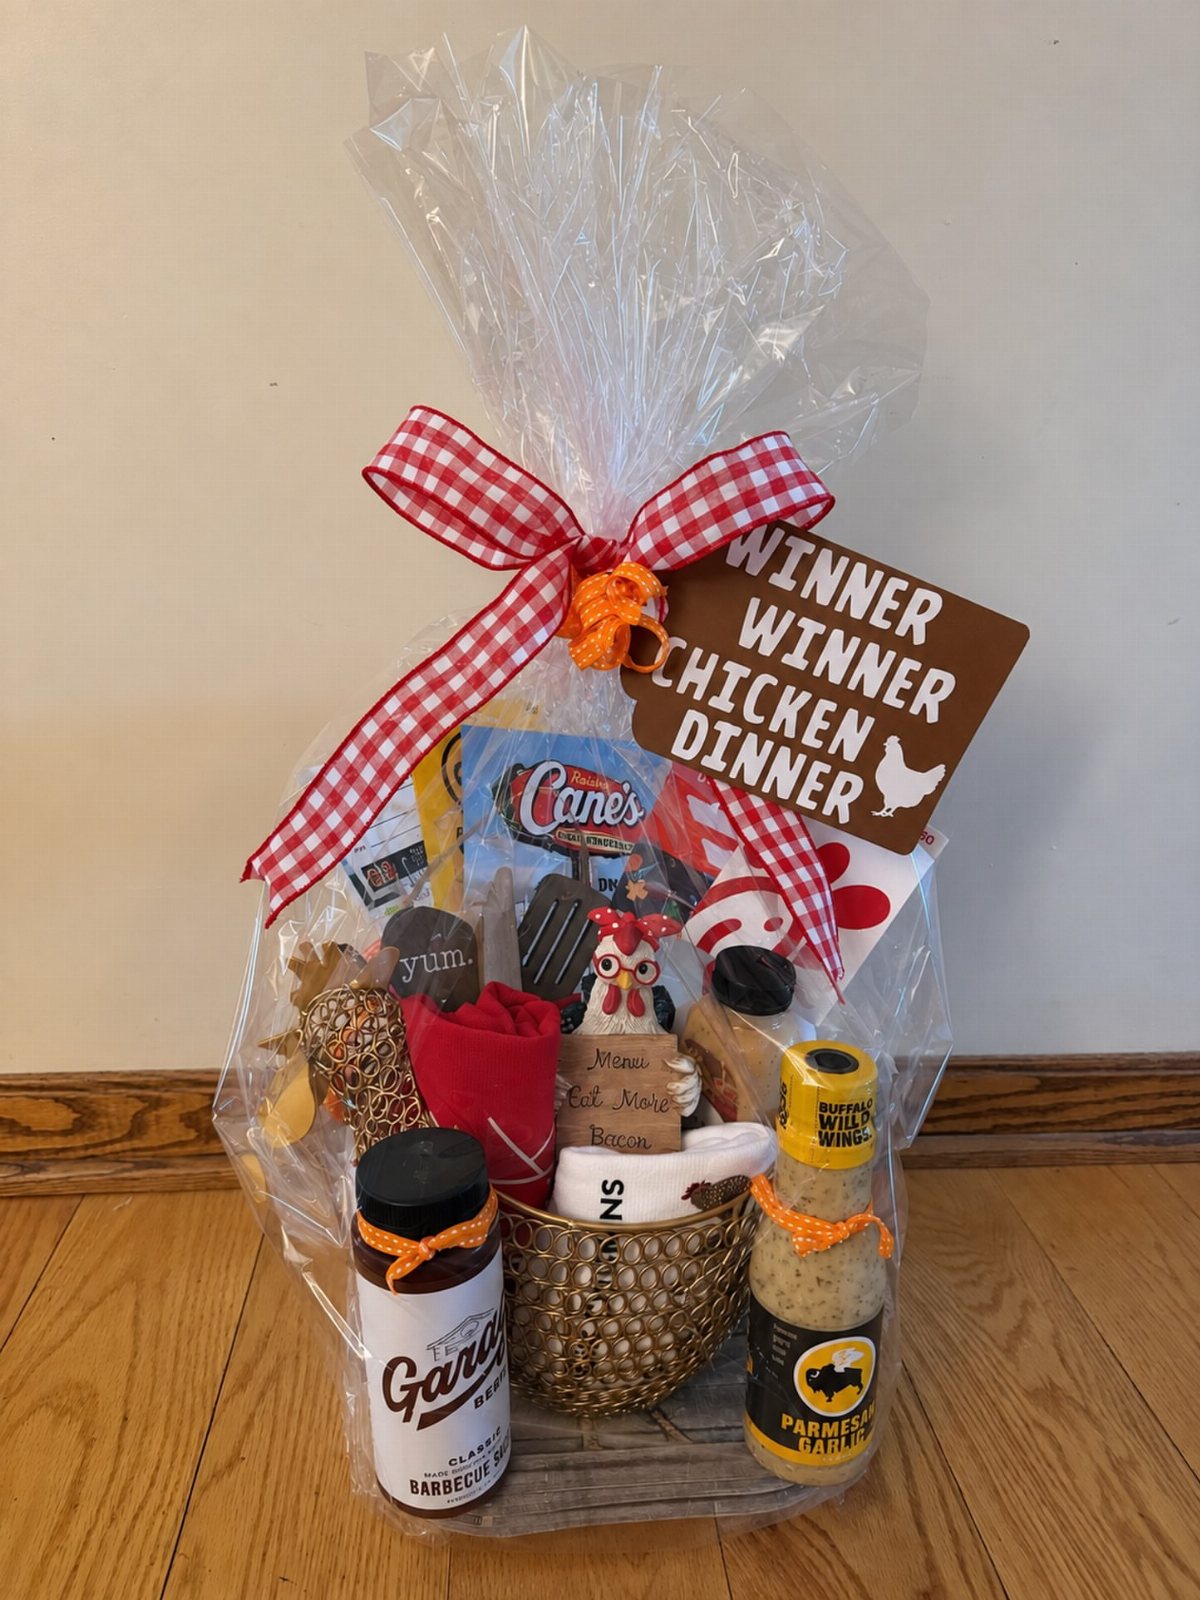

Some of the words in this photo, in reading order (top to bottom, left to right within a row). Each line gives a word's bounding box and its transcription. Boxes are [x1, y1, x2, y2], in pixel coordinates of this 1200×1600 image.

[724, 524, 943, 646] WINNER
[738, 597, 956, 724] WINNER
[651, 636, 876, 763] CHICKEN
[670, 708, 865, 825] DINNER
[519, 760, 645, 836] Cane's
[400, 947, 474, 983] yum.
[587, 1048, 650, 1071] Menu
[567, 1085, 604, 1108] Eat
[612, 1088, 670, 1113] More
[819, 1098, 874, 1115] BUFFALO
[590, 1124, 652, 1150] Bacon
[819, 1110, 871, 1131] WILD
[448, 1426, 501, 1467] CLASSIC
[798, 1428, 866, 1455] GARLIC
[409, 1459, 491, 1497] BARBECUE
